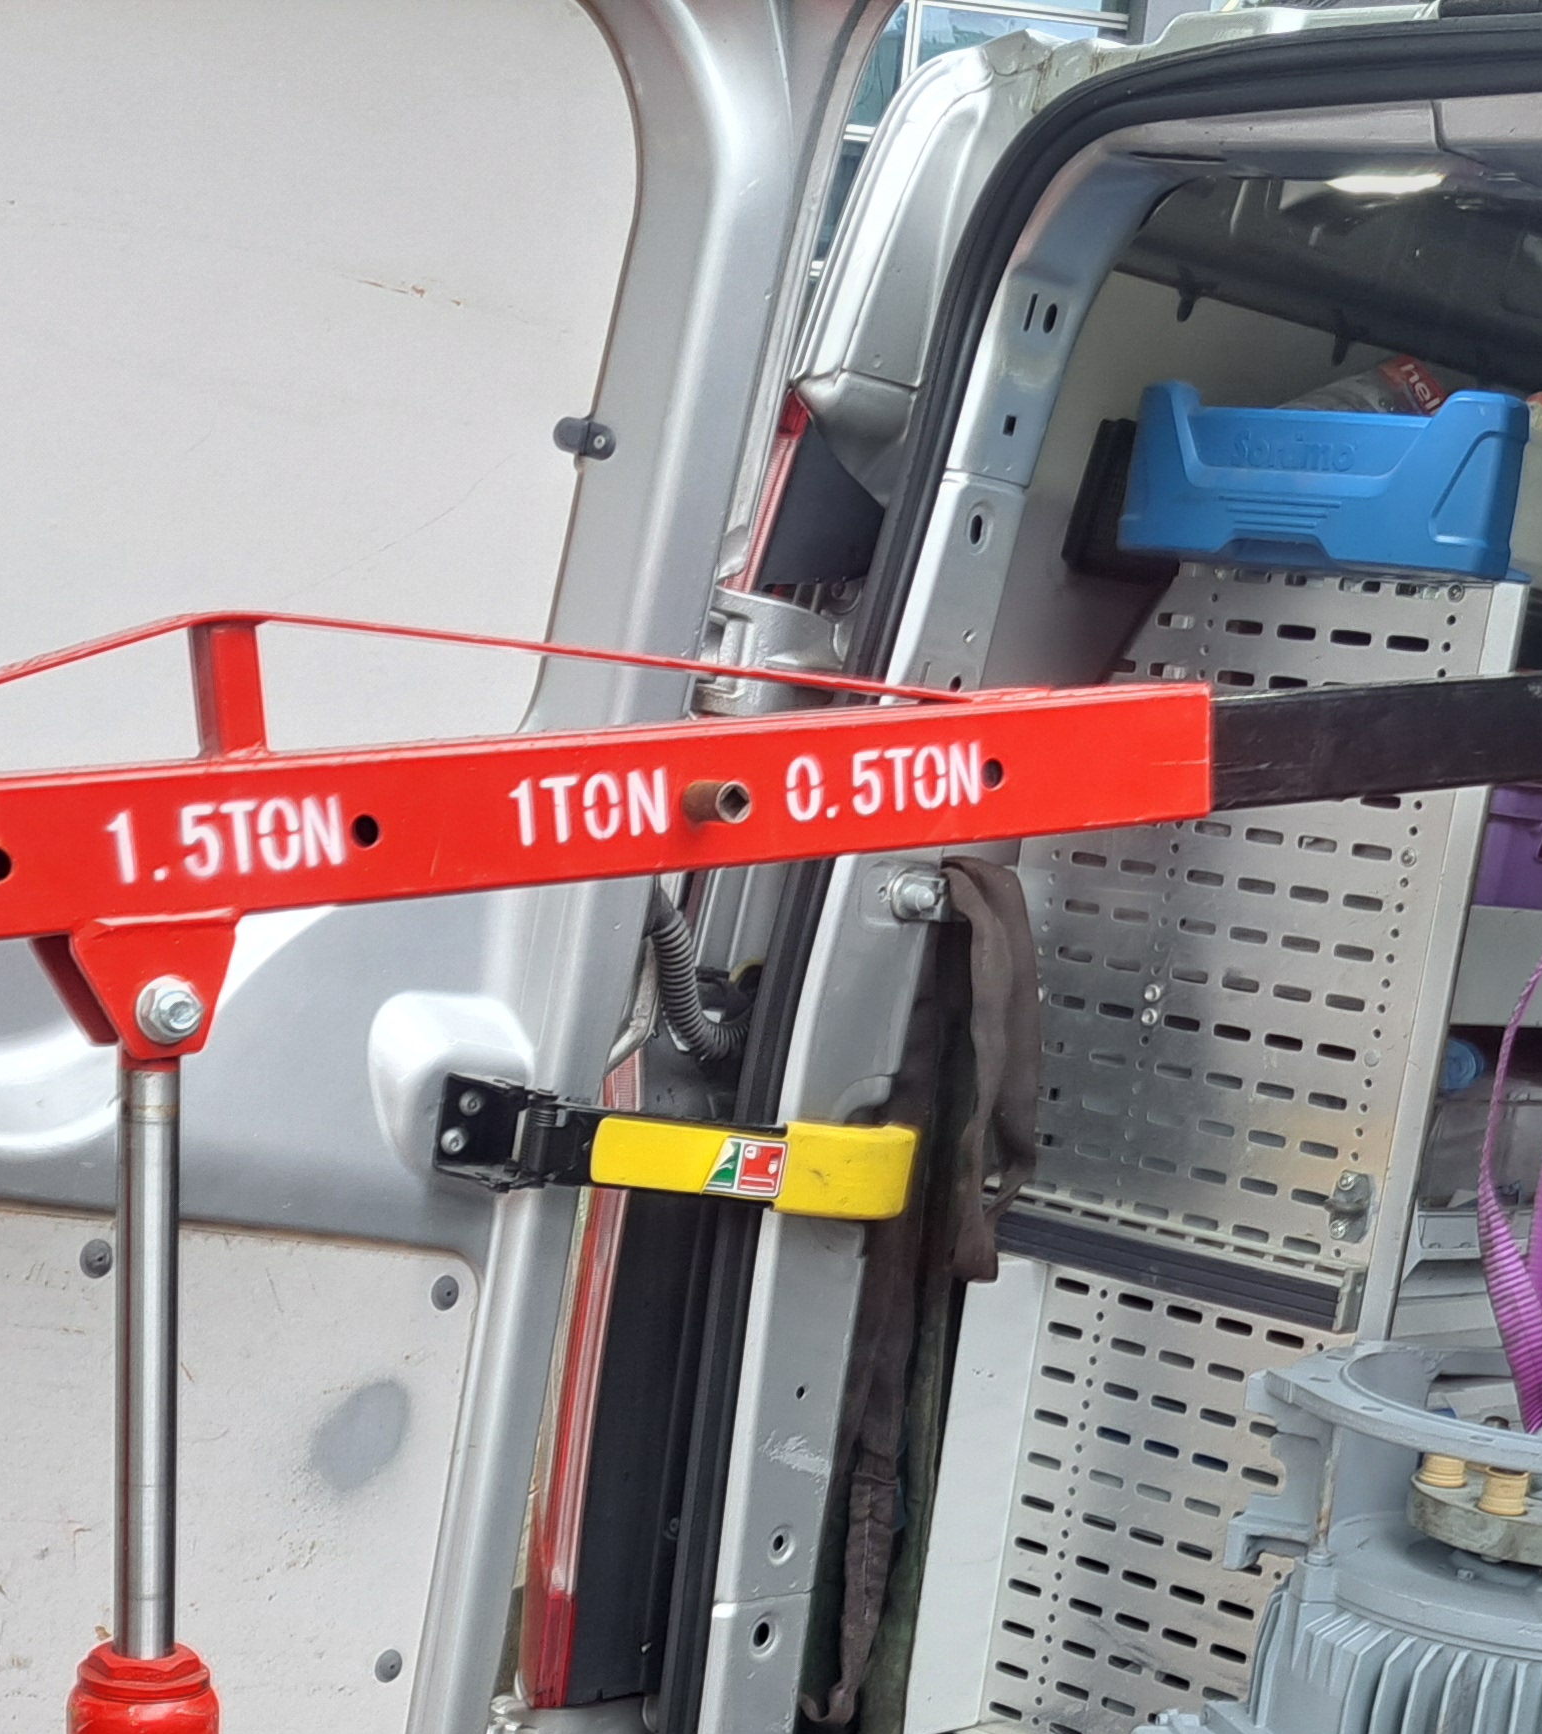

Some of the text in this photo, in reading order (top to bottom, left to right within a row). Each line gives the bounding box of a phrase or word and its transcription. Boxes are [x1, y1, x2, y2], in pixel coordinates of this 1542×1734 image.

[105, 796, 347, 886] 1.5TON
[509, 768, 669, 847] 1TON
[785, 741, 982, 822] 0.5TON
